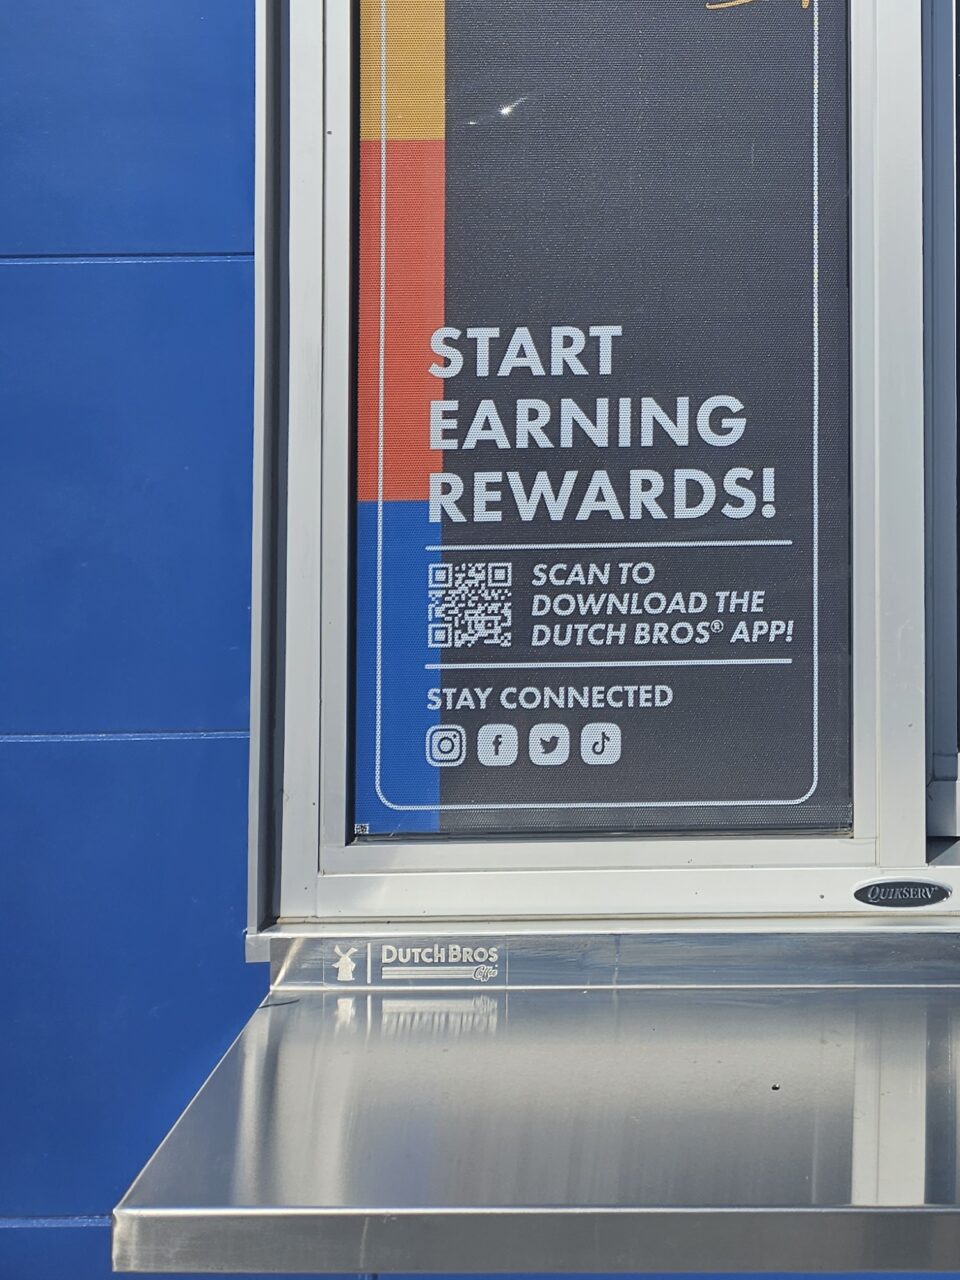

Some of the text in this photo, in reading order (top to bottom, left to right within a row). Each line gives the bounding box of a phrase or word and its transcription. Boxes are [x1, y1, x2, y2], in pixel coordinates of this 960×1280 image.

[429, 325, 622, 378] START
[429, 395, 747, 450] EARNING
[428, 468, 776, 522] REWARDS!
[532, 562, 655, 586] SCAN TO
[532, 590, 766, 616] DOWNLOAD THE
[532, 623, 627, 647] DUTCH
[730, 620, 794, 643] APP!
[427, 686, 673, 710] STAY CONNECTED
